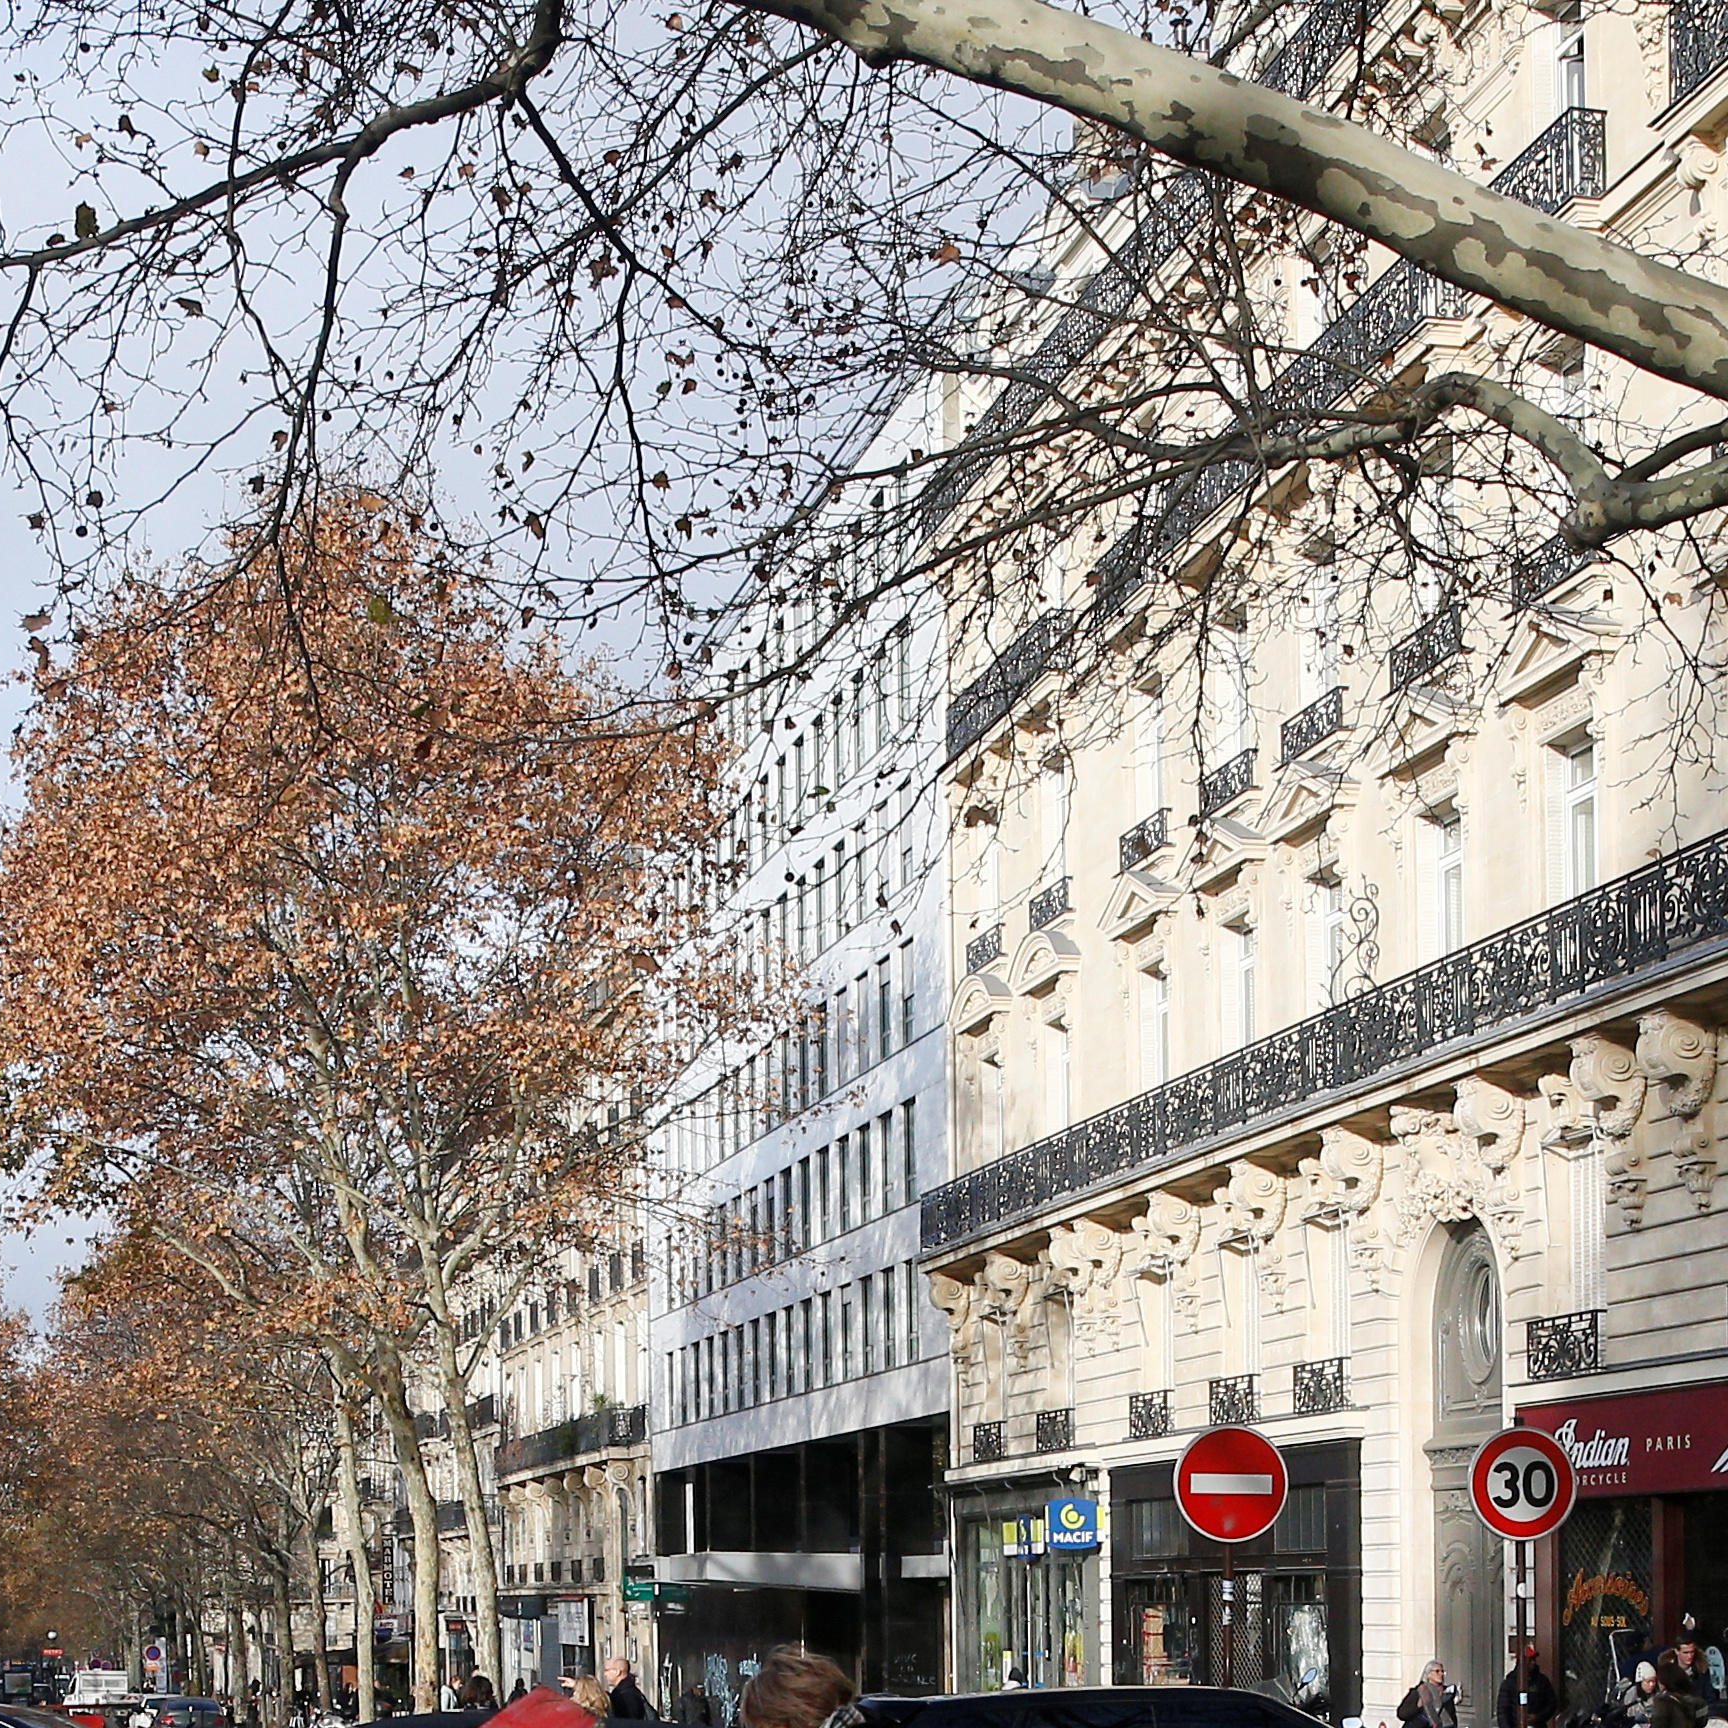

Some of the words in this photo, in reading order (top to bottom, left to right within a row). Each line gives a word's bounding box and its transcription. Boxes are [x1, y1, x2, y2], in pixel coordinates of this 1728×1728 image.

[1554, 1418, 1631, 1470] Indian
[1645, 1433, 1692, 1453] PARIS
[1492, 1460, 1556, 1509] 30
[1053, 1531, 1094, 1544] MACIF
